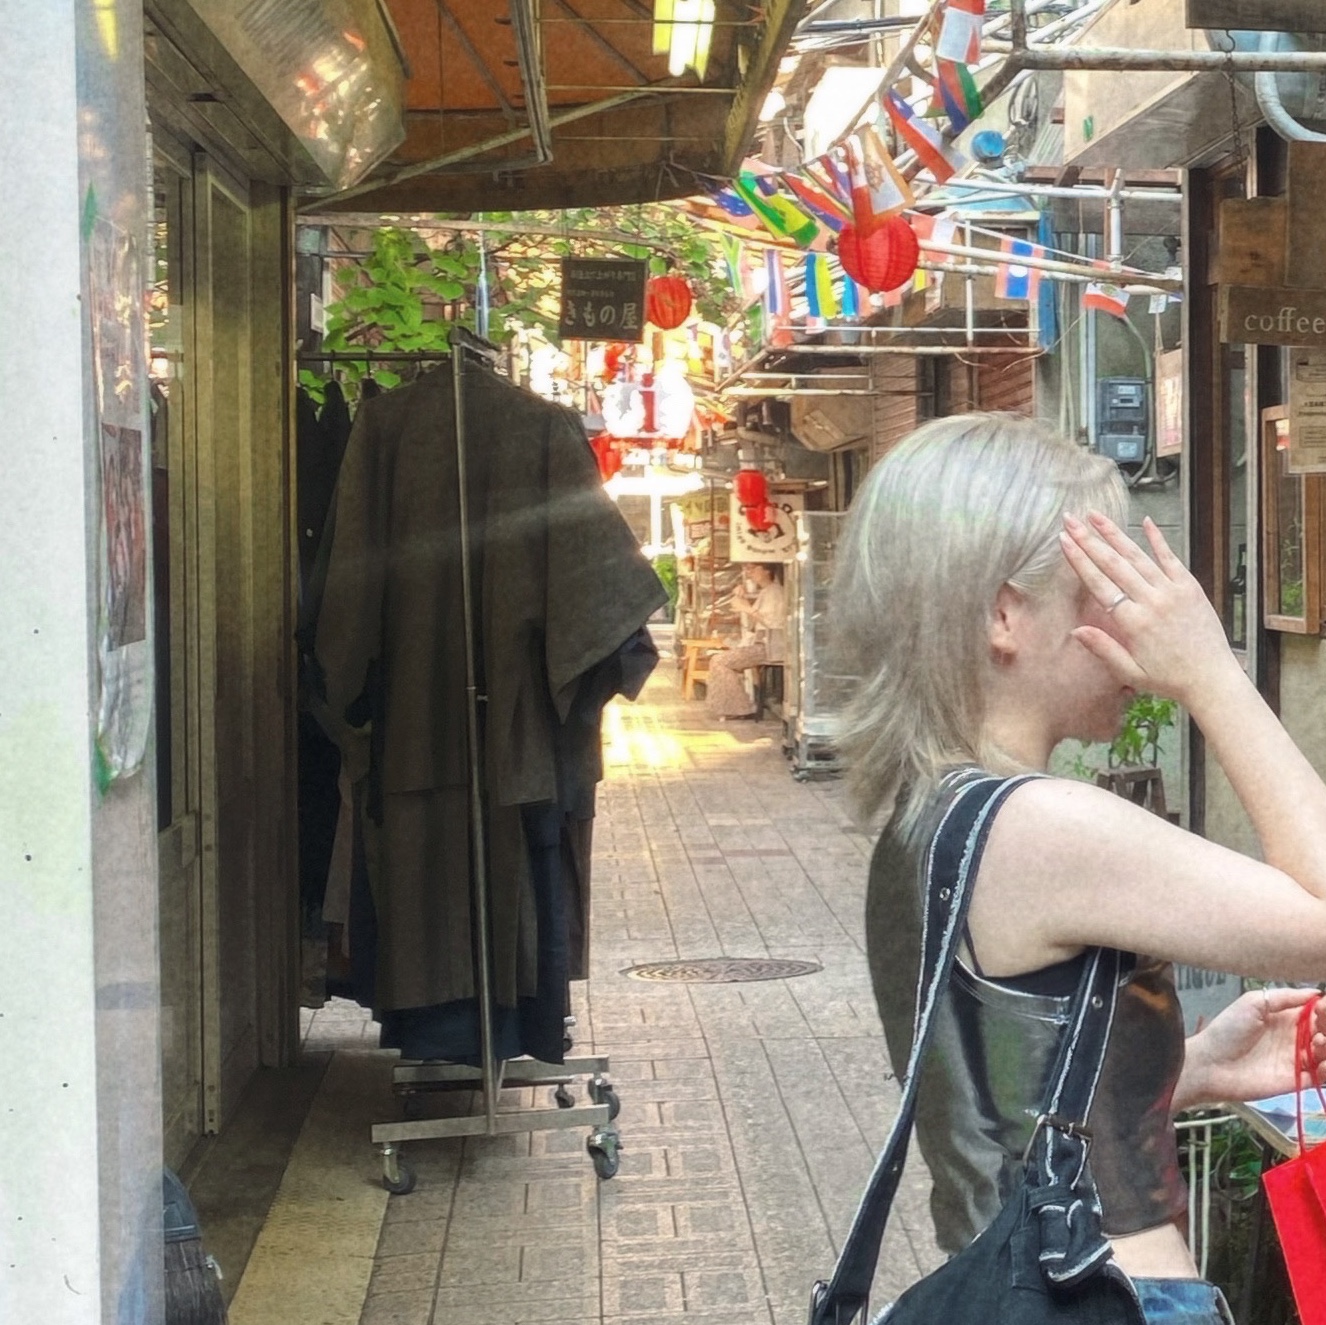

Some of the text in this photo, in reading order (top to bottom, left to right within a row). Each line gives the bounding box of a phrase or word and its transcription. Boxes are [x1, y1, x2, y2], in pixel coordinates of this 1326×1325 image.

[564, 299, 638, 330] きもの屋
[1244, 306, 1326, 334] coffee
